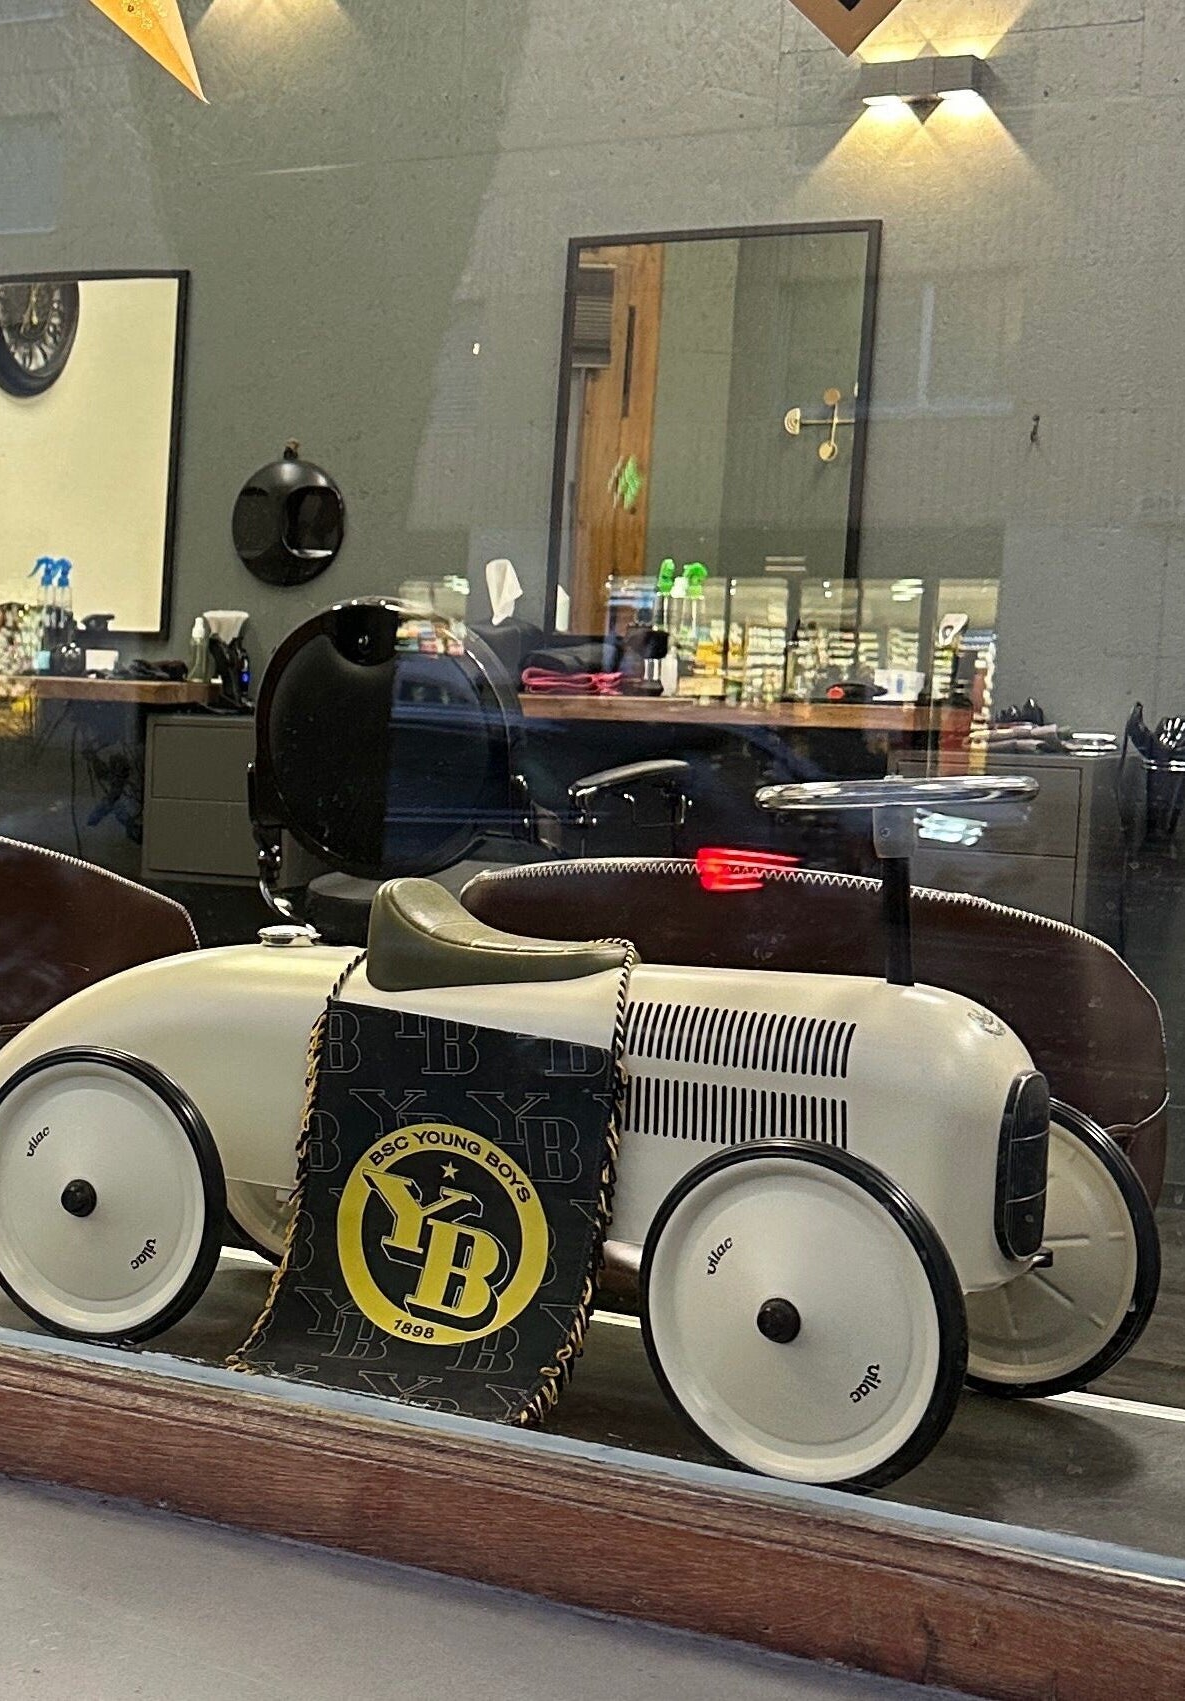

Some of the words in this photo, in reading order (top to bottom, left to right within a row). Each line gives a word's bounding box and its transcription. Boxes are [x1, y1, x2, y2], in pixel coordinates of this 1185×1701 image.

[26, 1126, 50, 1158] vilac
[368, 1135, 410, 1167] BSC
[411, 1130, 482, 1156] YOUNG
[483, 1151, 532, 1204] BOYS
[130, 1238, 157, 1270] vilac
[362, 1168, 510, 1332] YB
[707, 1235, 733, 1276] vilac
[393, 1318, 435, 1340] 1898
[849, 1363, 882, 1404] vilac
